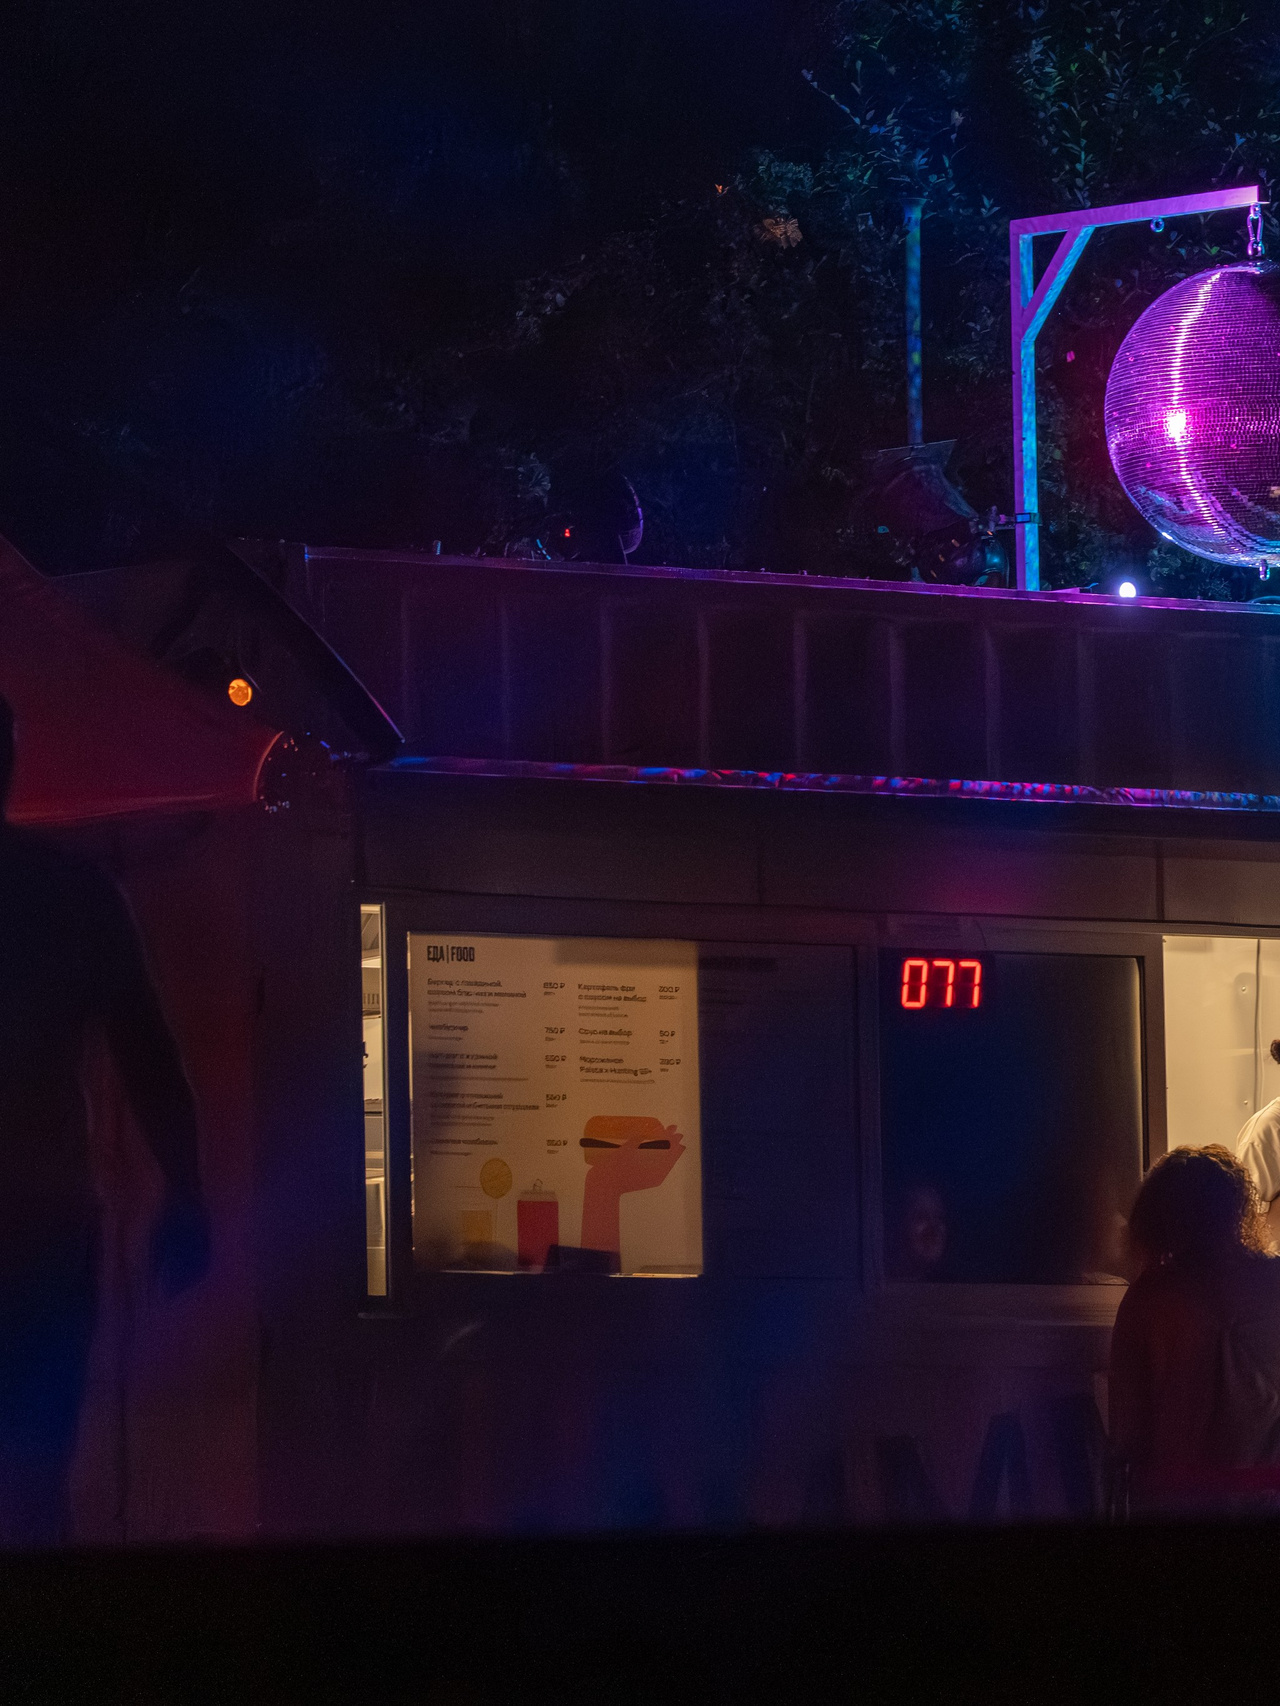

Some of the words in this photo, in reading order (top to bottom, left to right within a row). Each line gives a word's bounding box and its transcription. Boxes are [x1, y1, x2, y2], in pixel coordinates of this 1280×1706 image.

[427, 945, 445, 963] ЕДА
[451, 946, 475, 962] FOOD
[901, 958, 982, 1009] 077
